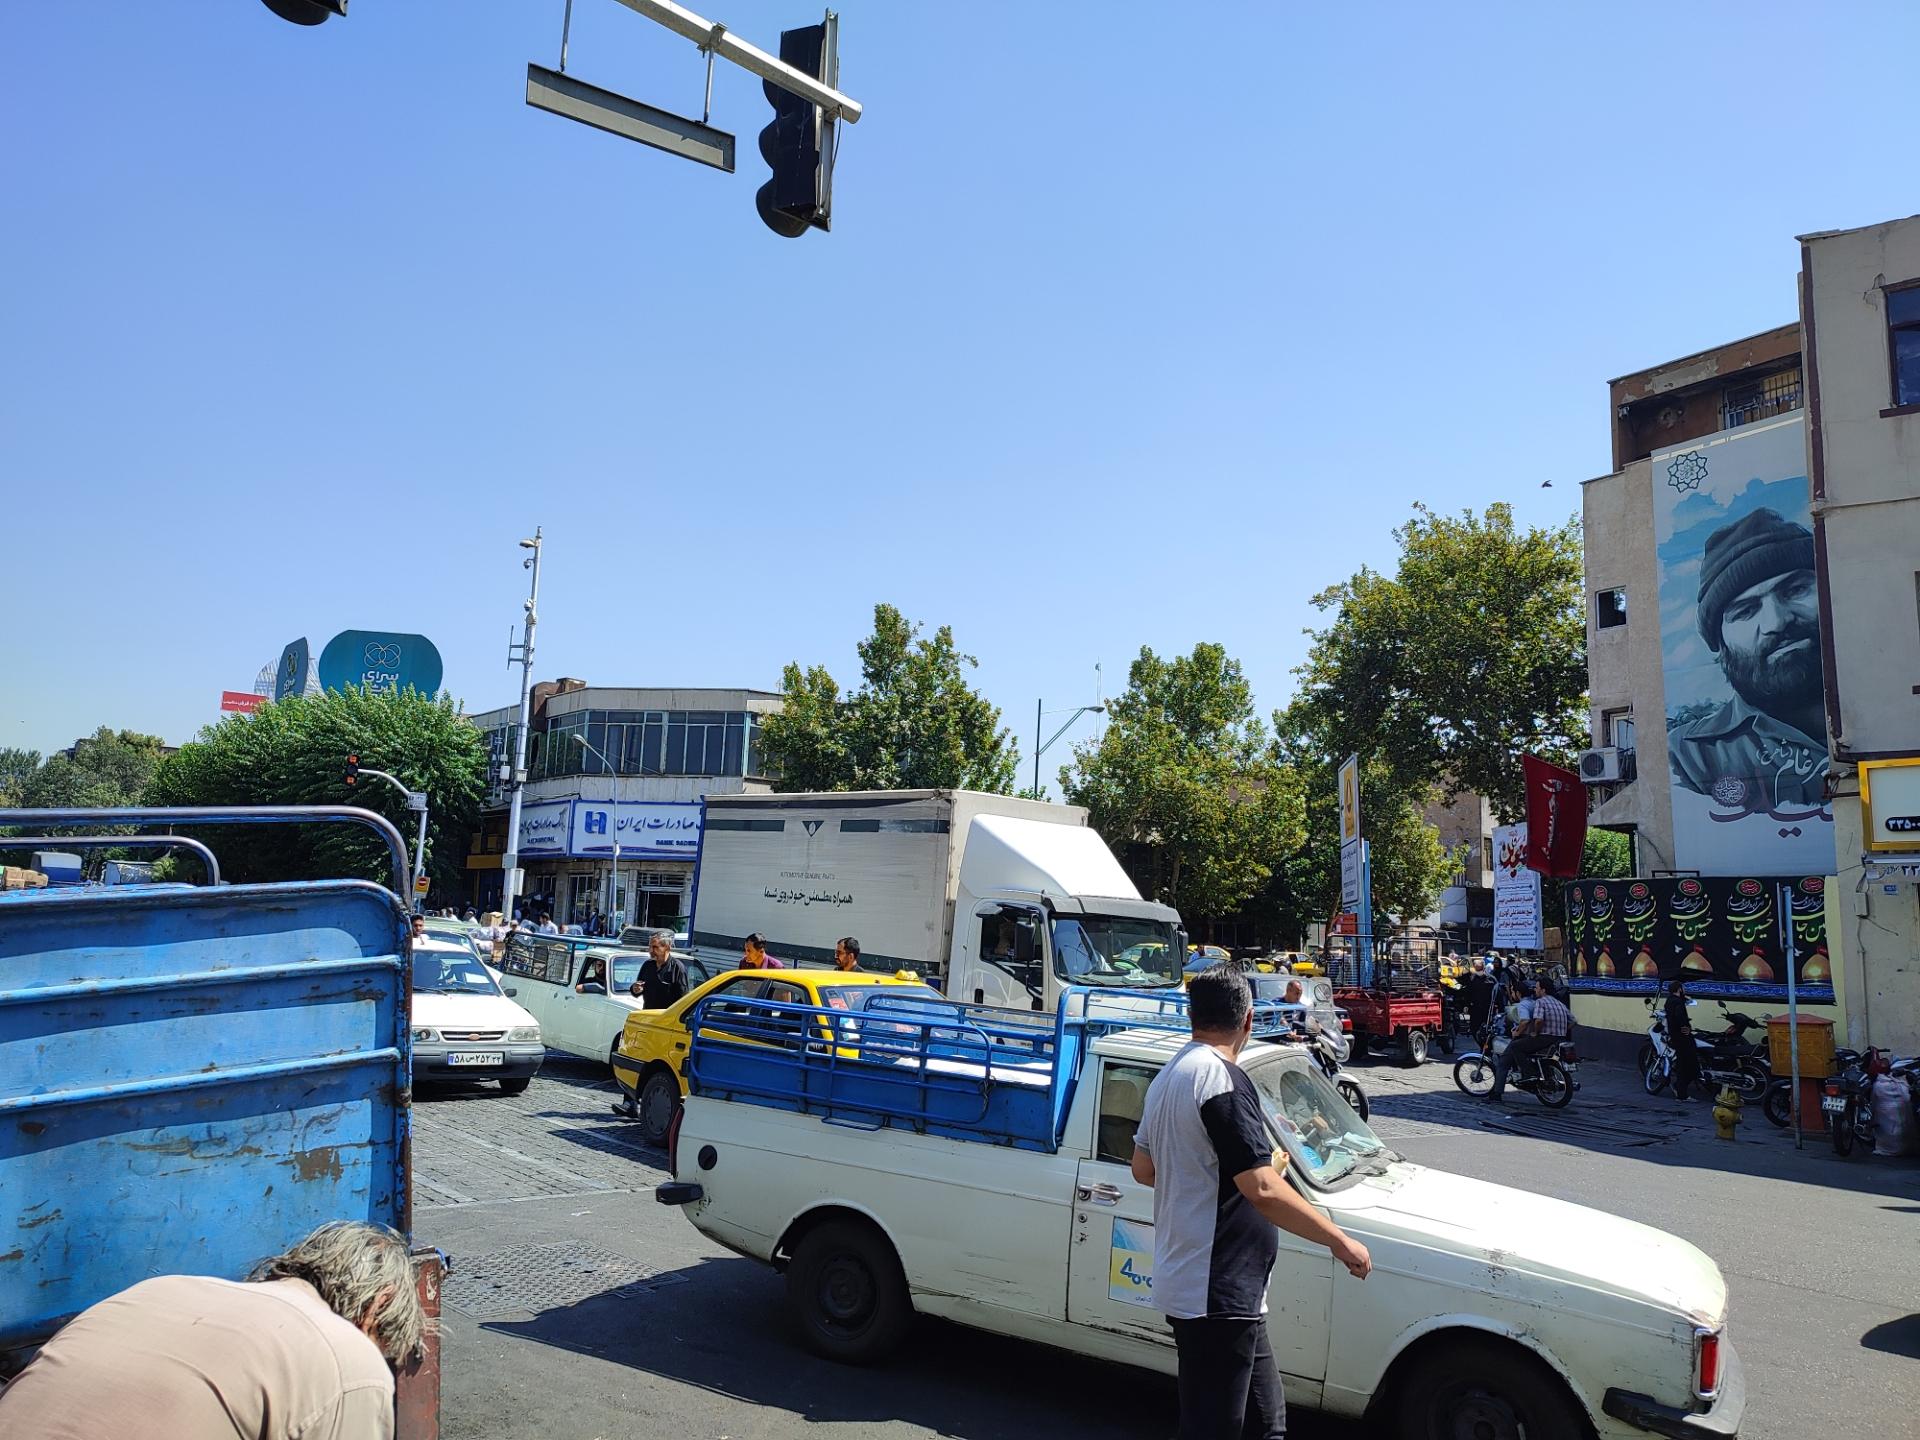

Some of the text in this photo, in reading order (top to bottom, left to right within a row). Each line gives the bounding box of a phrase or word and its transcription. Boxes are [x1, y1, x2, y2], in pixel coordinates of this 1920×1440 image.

[362, 670, 399, 683] سرای
[616, 816, 646, 833] ایران
[647, 816, 694, 830] صادرات
[764, 886, 778, 898] شما
[833, 890, 853, 907] همراه
[1684, 911, 1713, 941] حسین
[1742, 912, 1774, 943] حسین
